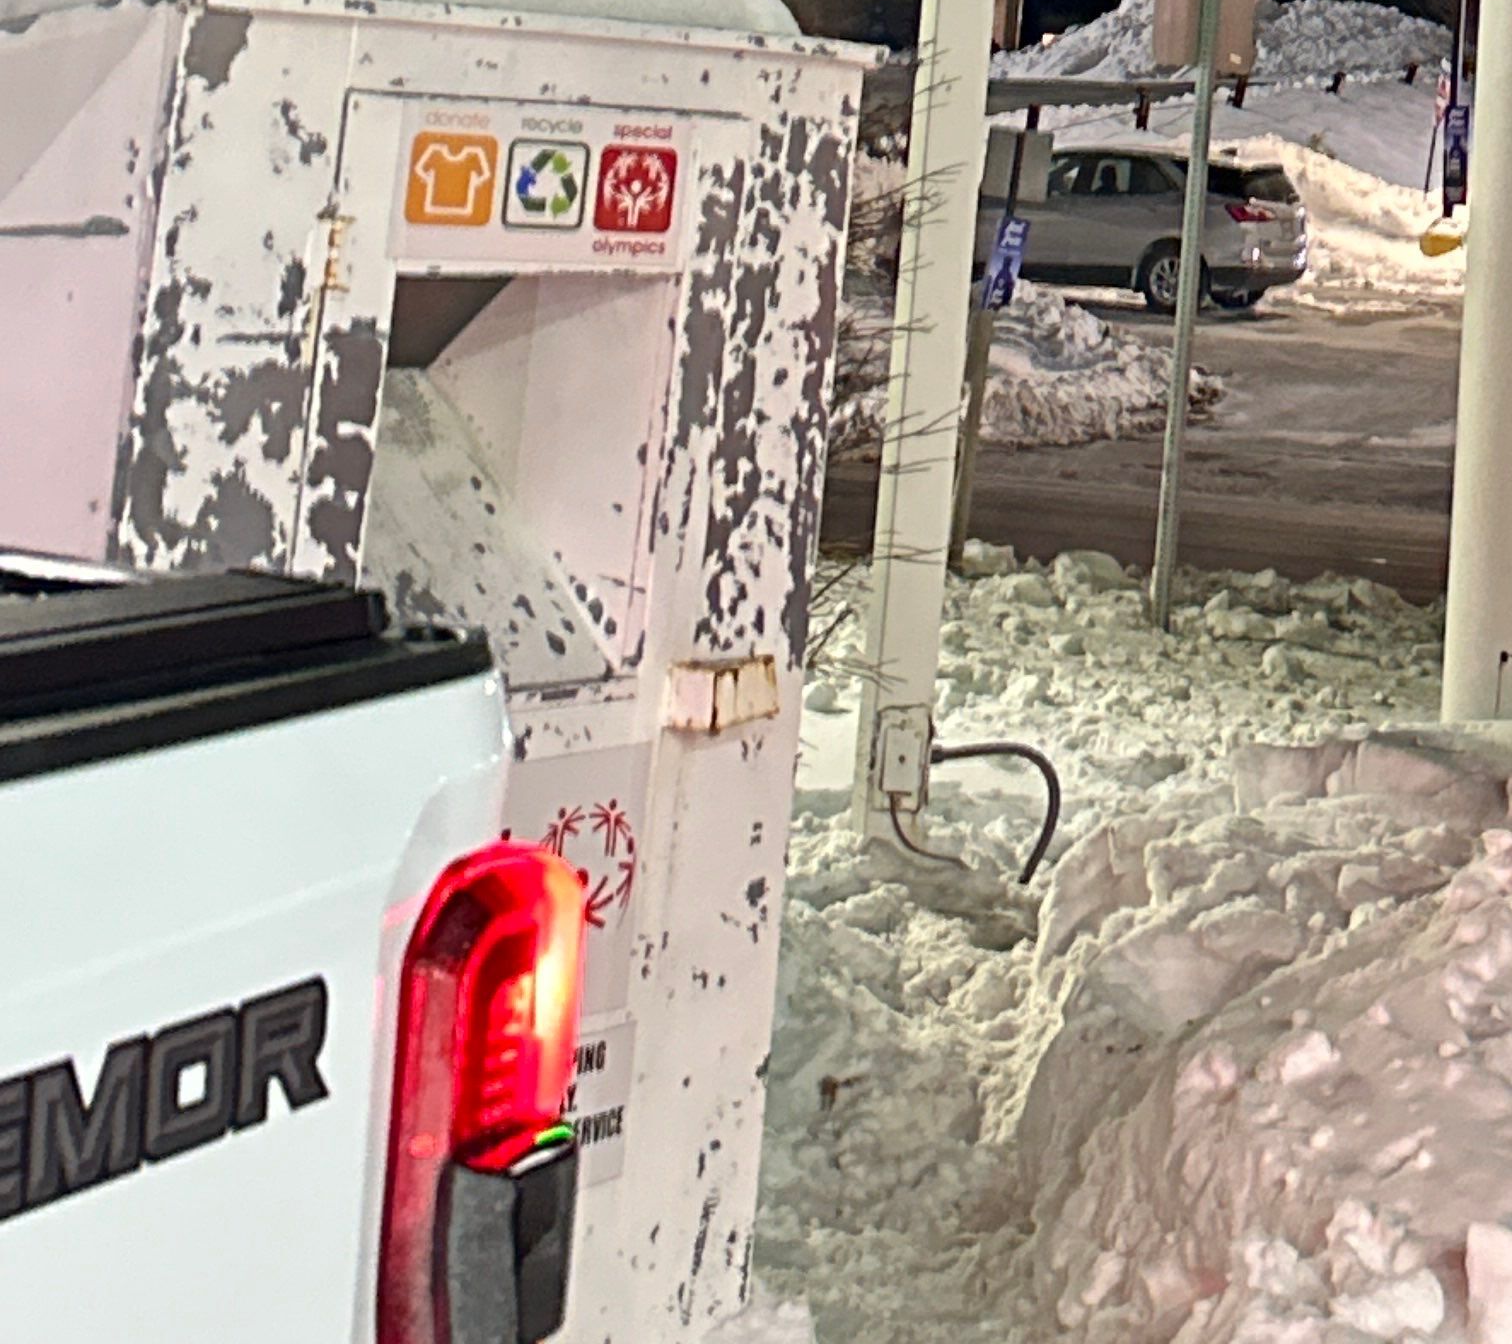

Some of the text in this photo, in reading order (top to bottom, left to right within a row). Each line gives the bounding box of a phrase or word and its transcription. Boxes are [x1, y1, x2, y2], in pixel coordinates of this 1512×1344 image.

[425, 110, 491, 129] donate
[521, 116, 583, 134] recycle
[614, 123, 673, 140] special
[592, 239, 666, 256] olympics
